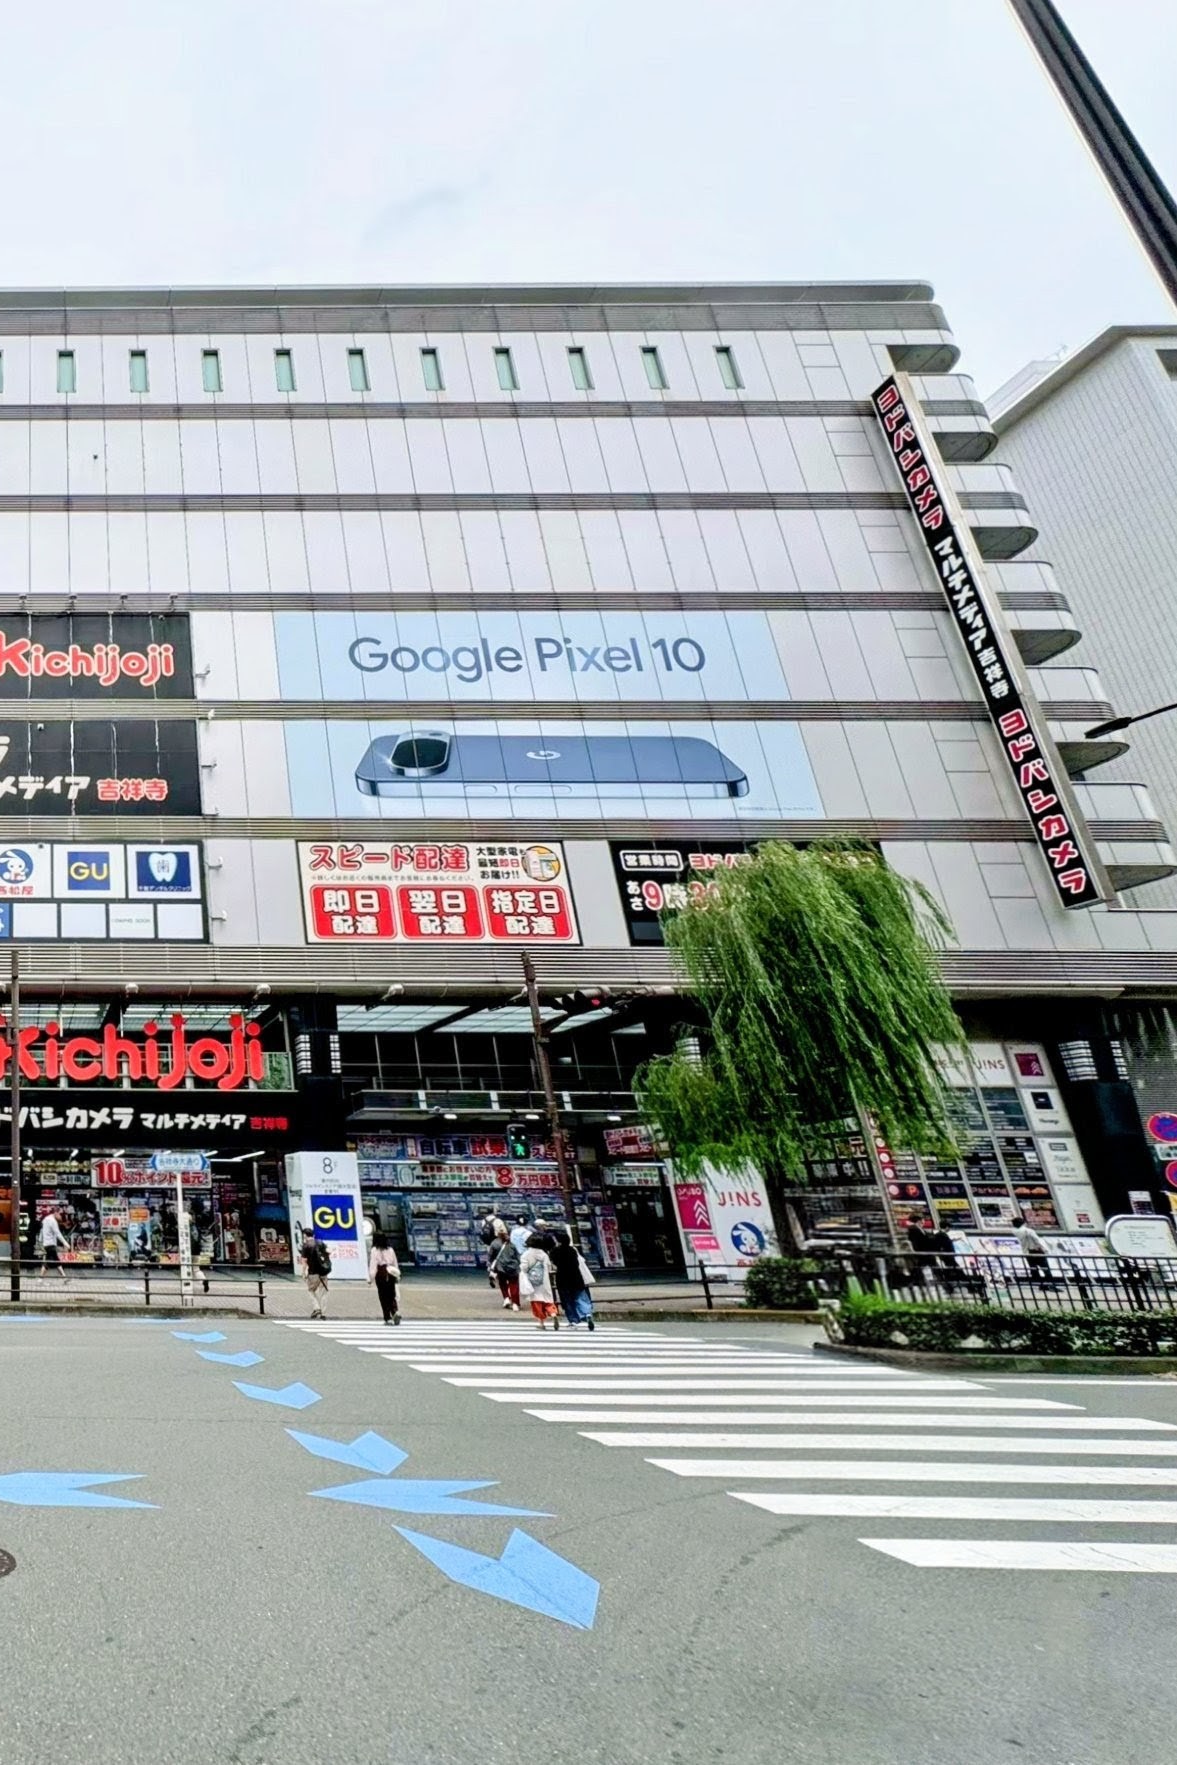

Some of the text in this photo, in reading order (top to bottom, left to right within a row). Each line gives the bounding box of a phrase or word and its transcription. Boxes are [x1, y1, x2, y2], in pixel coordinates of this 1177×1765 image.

[877, 384, 944, 530] ヨドバシカメラ
[999, 708, 1086, 894] ヨドバシカメラ
[348, 637, 706, 682] Google Pixel 10
[96, 778, 168, 802] 吉祥寺
[69, 861, 109, 880] GU
[309, 844, 470, 873] スピード配達
[324, 889, 380, 914] 即日
[408, 889, 468, 914] 翌日
[491, 890, 561, 914] 指定日
[331, 916, 379, 935] 配達
[419, 916, 466, 935] 配達
[504, 916, 556, 935] 配達
[140, 1112, 247, 1130] マルチメディア
[314, 1206, 355, 1229] GU
